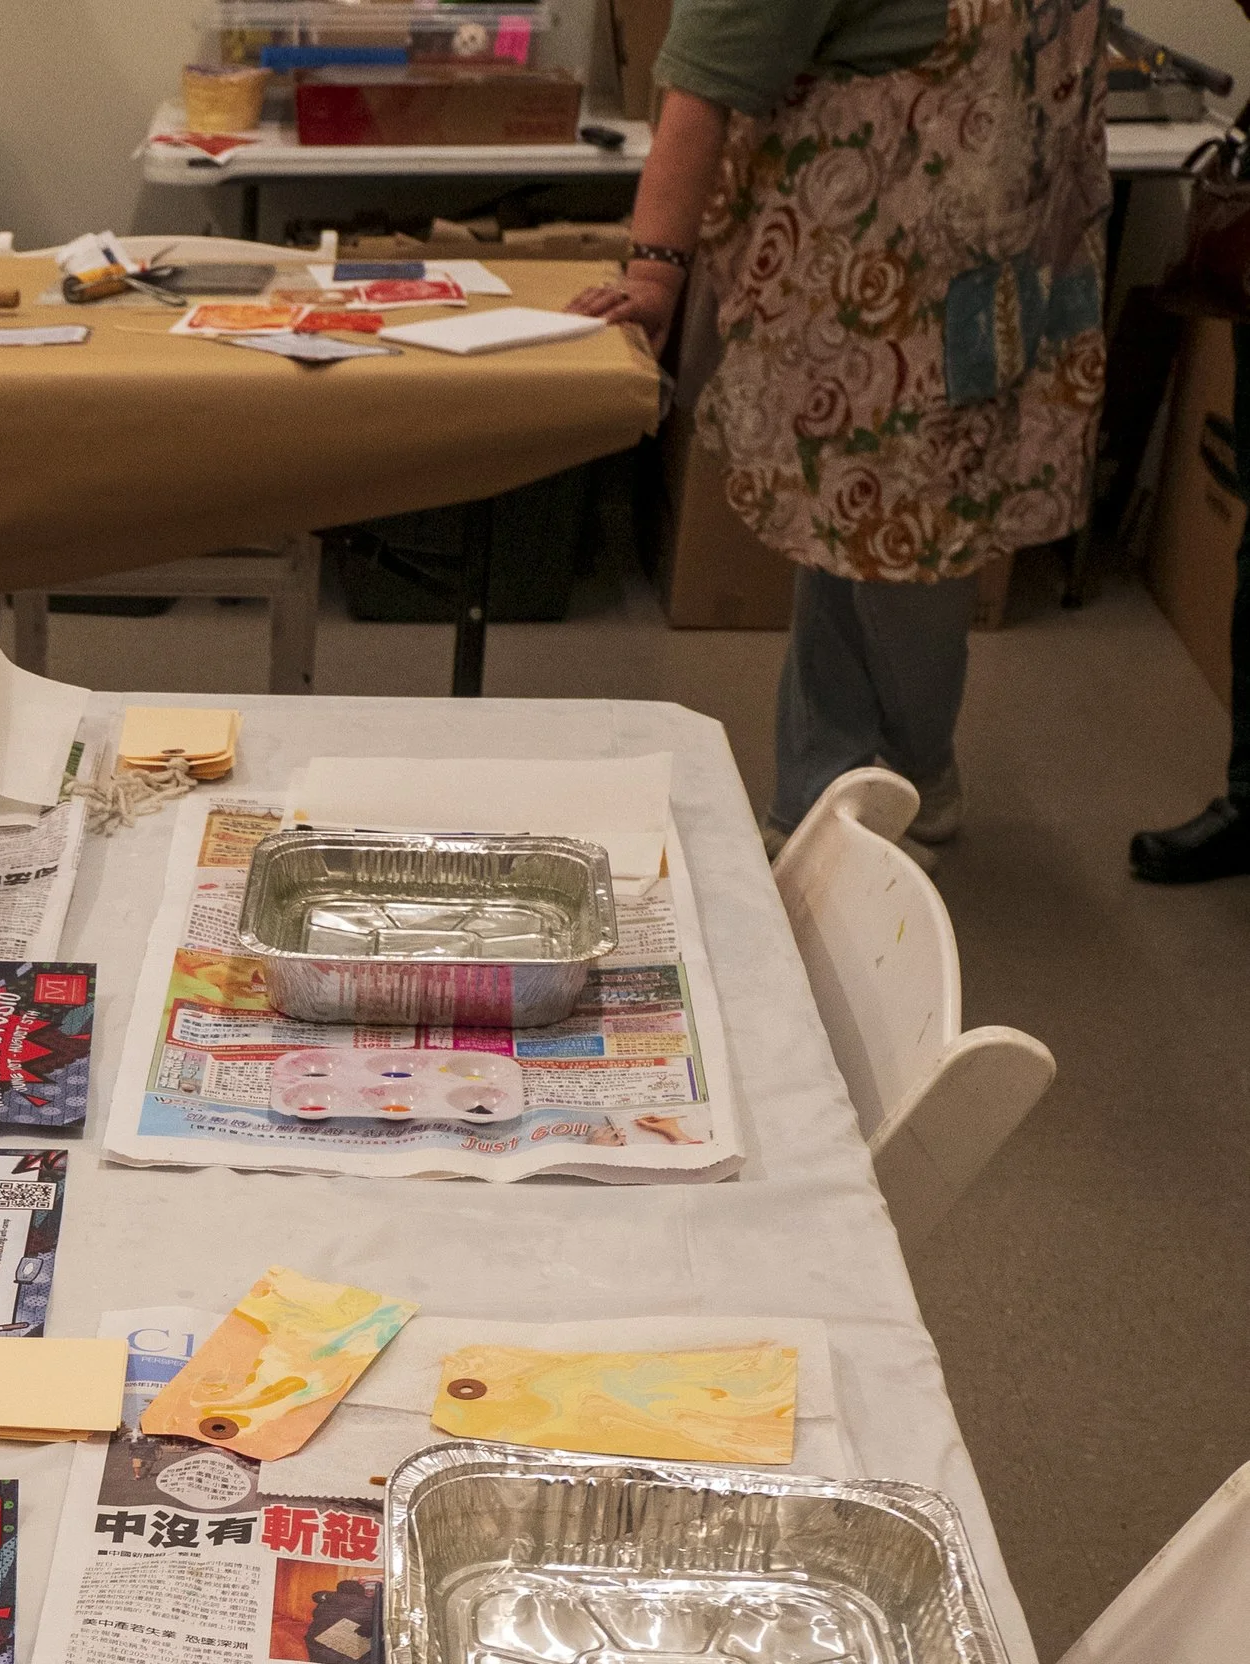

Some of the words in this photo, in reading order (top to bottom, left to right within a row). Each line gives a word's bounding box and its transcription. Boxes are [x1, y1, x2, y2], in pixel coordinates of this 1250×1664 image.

[9, 1026, 28, 1053] AUGUST
[21, 1010, 40, 1024] 5TH
[460, 1136, 521, 1153] Just
[127, 1328, 195, 1358] C1
[81, 1618, 178, 1640] 美中產若失業
